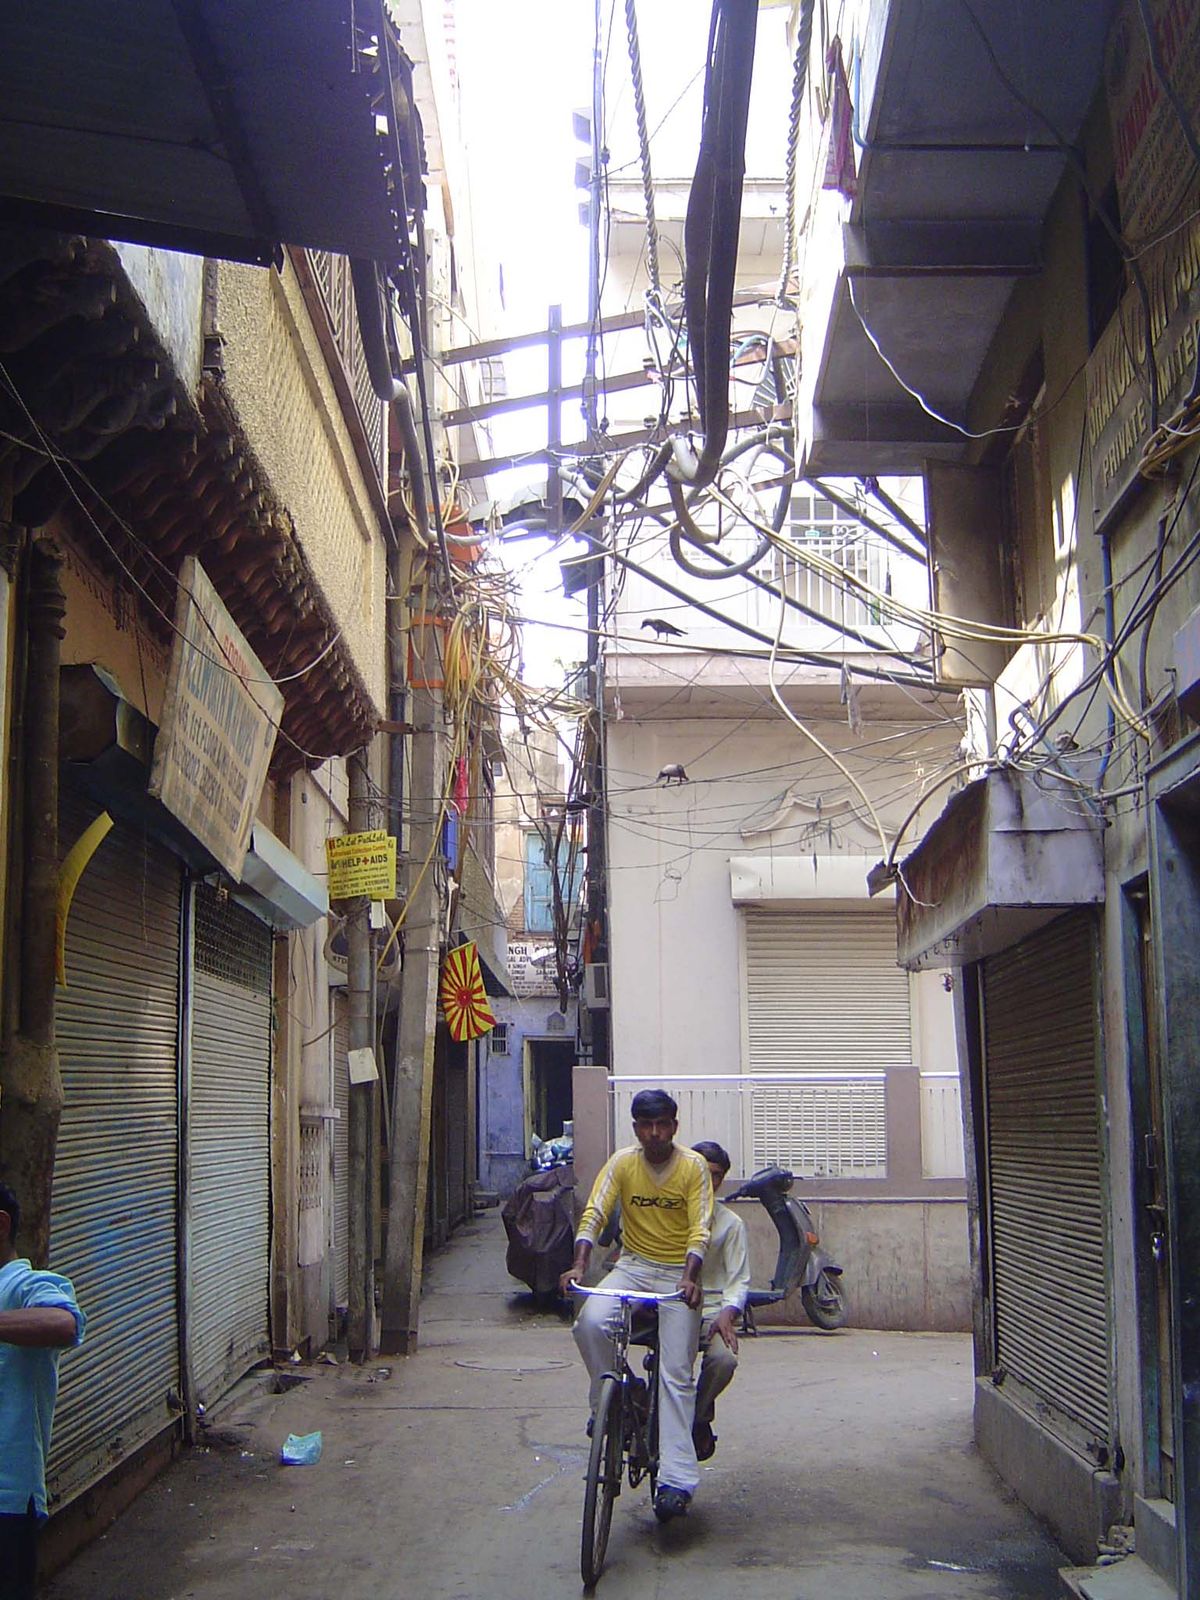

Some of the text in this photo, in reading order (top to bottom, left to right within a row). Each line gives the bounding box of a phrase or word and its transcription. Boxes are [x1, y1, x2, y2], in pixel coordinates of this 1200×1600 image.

[1102, 398, 1146, 486] PRIVATE
[342, 857, 361, 868] HELP
[371, 854, 387, 864] AIDS
